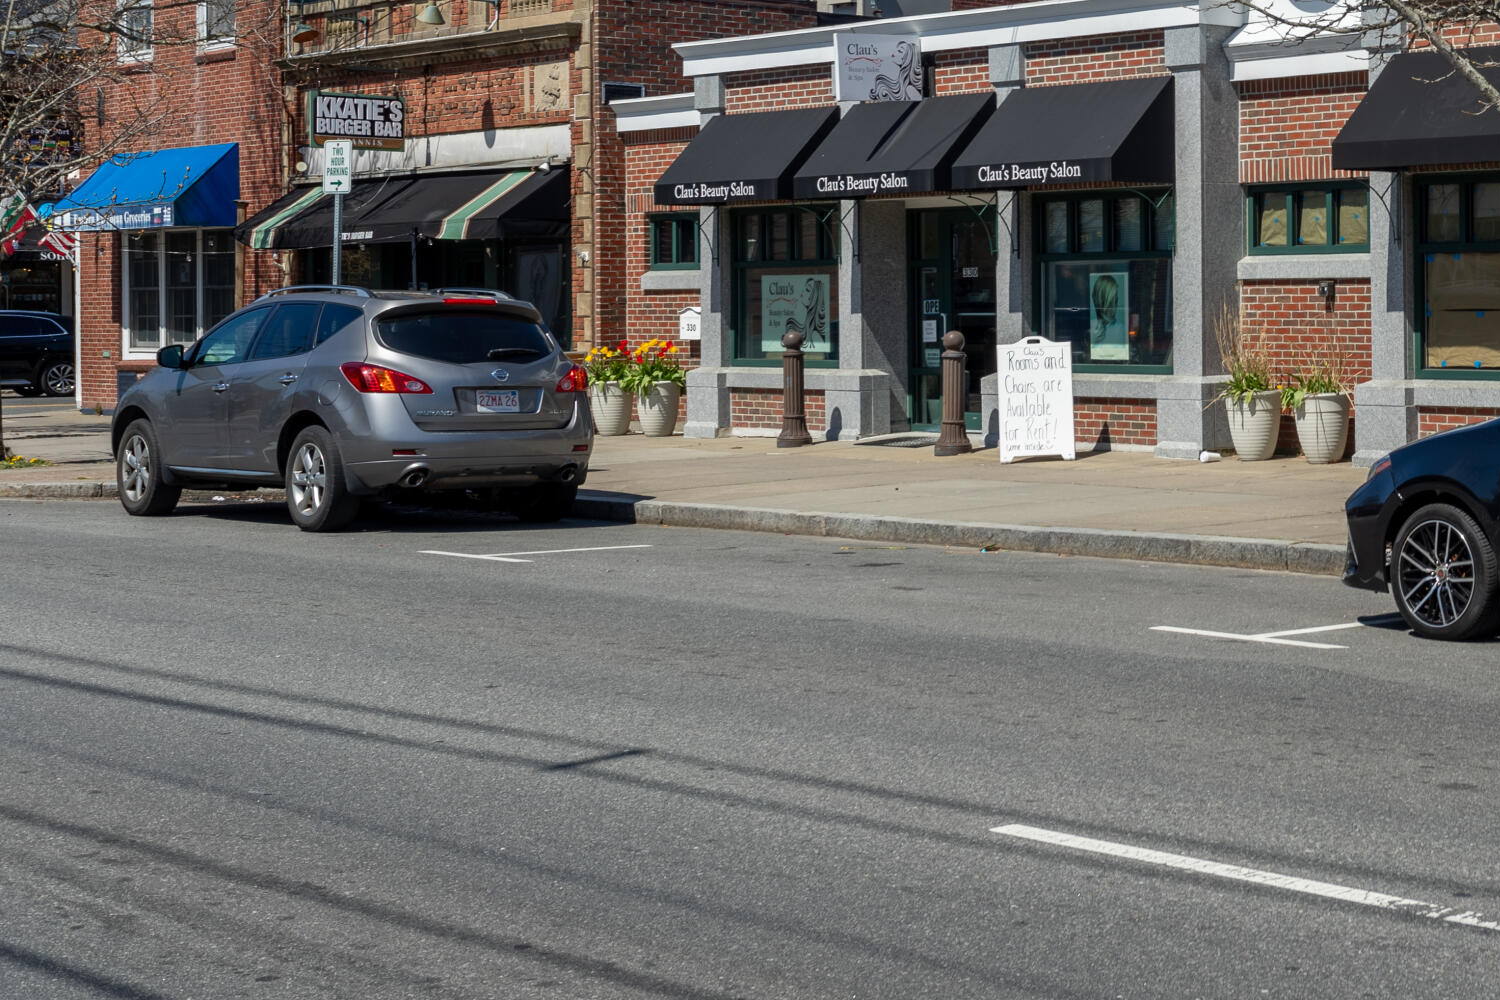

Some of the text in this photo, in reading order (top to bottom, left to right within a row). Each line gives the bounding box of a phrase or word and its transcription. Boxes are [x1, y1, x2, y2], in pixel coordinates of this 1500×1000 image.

[847, 43, 878, 56] Clau's
[316, 96, 403, 122] KKATIE'S
[316, 117, 402, 138] BURGER BAR
[332, 147, 344, 156] TWO
[331, 157, 345, 166] HOUR
[326, 167, 349, 176] PARKING
[978, 161, 1081, 183] Clau's Beauty Salon
[674, 181, 755, 200] Clau's Beauty Salon
[816, 173, 908, 192] Clau's Beauty Salon
[124, 210, 151, 224] Groceries
[768, 281, 794, 296] Clau's
[925, 300, 939, 313] OPE
[686, 323, 697, 332] 330
[1006, 347, 1067, 372] Rooms and
[1004, 374, 1063, 394] Chairs are
[505, 395, 518, 407] 26
[1006, 394, 1052, 417] Available
[1005, 420, 1019, 441] for
